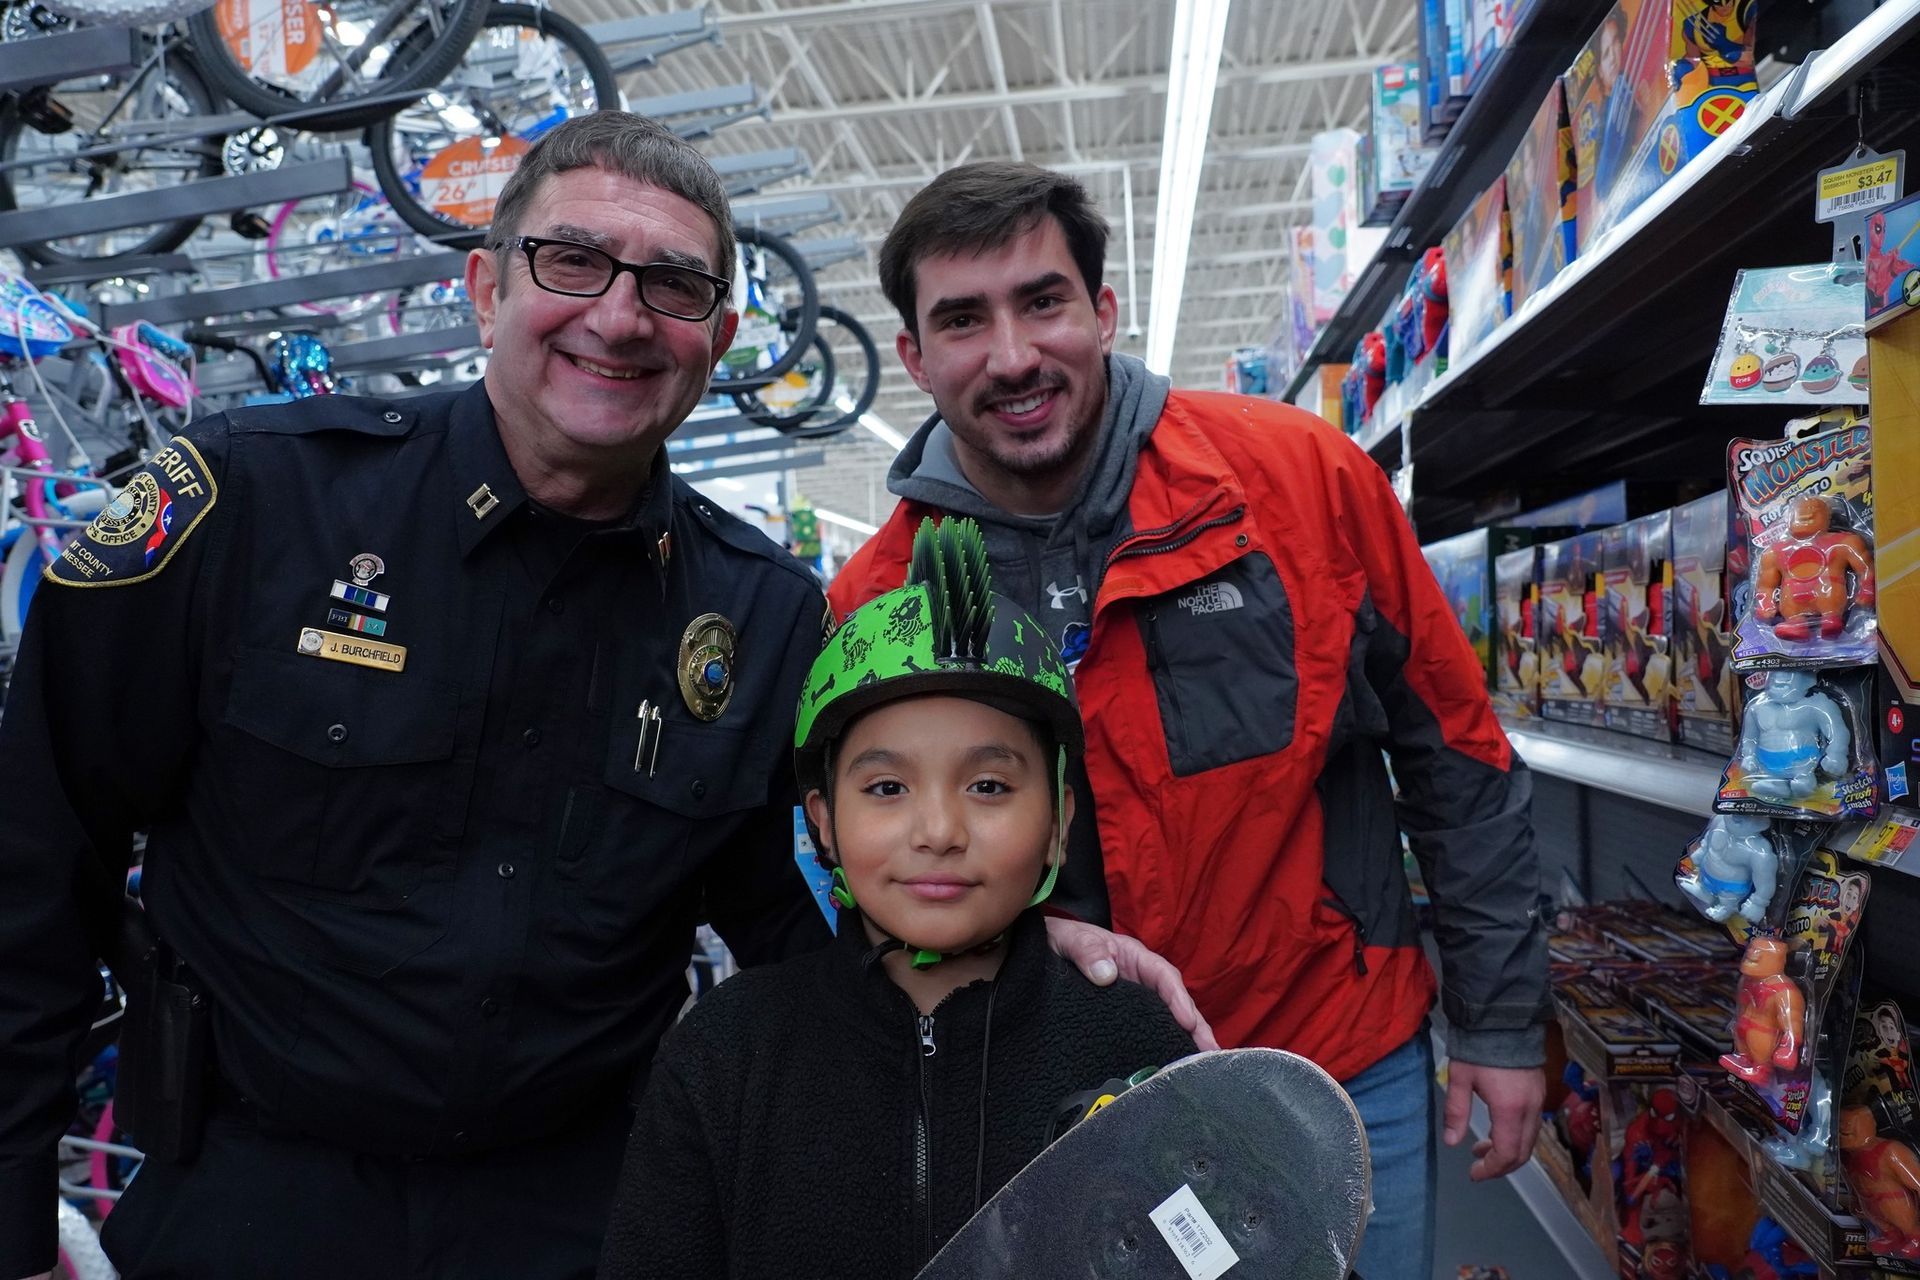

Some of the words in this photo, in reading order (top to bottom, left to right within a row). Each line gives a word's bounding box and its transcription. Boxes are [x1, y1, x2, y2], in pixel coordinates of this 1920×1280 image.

[1846, 167, 1874, 179] MONSTER
[1857, 169, 1893, 189] $3.47
[1735, 376, 1751, 385] Fries
[1739, 441, 1794, 473] SQUISH
[1742, 428, 1868, 505] MONSTER
[145, 478, 158, 516] COUNTY
[1781, 484, 1801, 499] Pocket
[101, 529, 137, 544] OFFICE
[78, 546, 114, 577] COUNTY
[1194, 583, 1219, 597] THE
[1177, 593, 1221, 609] NORTH
[1191, 601, 1223, 616] FACE
[330, 642, 339, 653] J.
[341, 643, 402, 664] BURCHFIELD
[1891, 713, 1902, 727] 4+
[1841, 775, 1873, 794] Stretch
[1844, 788, 1872, 802] crush
[1847, 799, 1873, 810] smash
